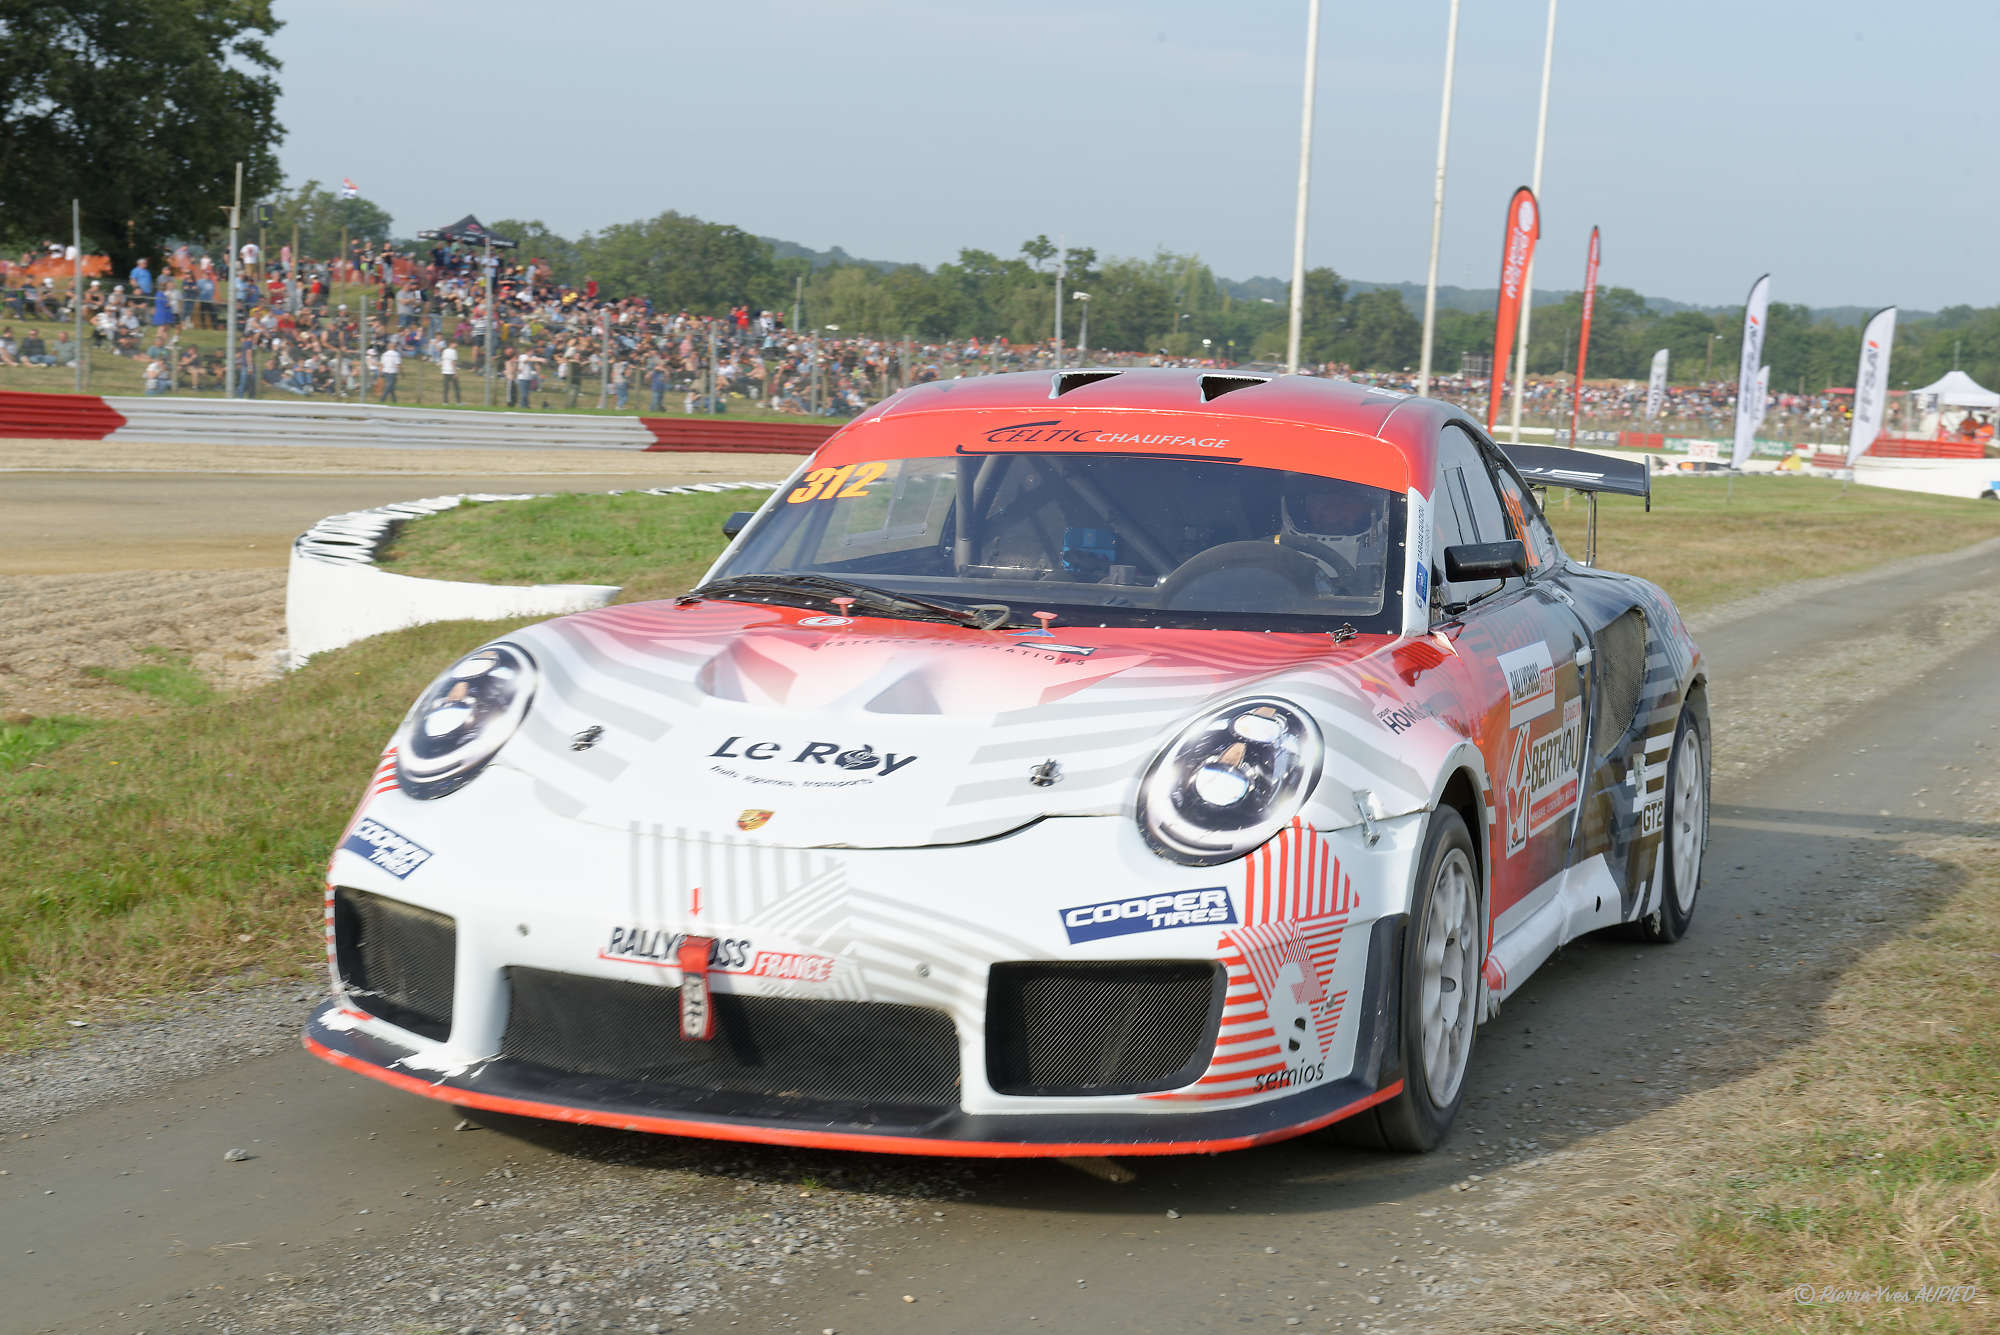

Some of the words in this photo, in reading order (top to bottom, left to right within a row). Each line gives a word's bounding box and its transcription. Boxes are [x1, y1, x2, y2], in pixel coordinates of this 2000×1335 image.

[986, 429, 1102, 443] CELTIC
[1095, 433, 1230, 449] CHAUFFAGE
[787, 462, 889, 504] 312
[706, 736, 781, 760] Le
[1530, 724, 1580, 793] BERTHOU
[1643, 800, 1664, 831] GT2
[1065, 889, 1227, 927] COOPER
[1146, 907, 1228, 928] TIRES
[754, 953, 834, 982] FRANCE
[1254, 1057, 1324, 1092] semios
